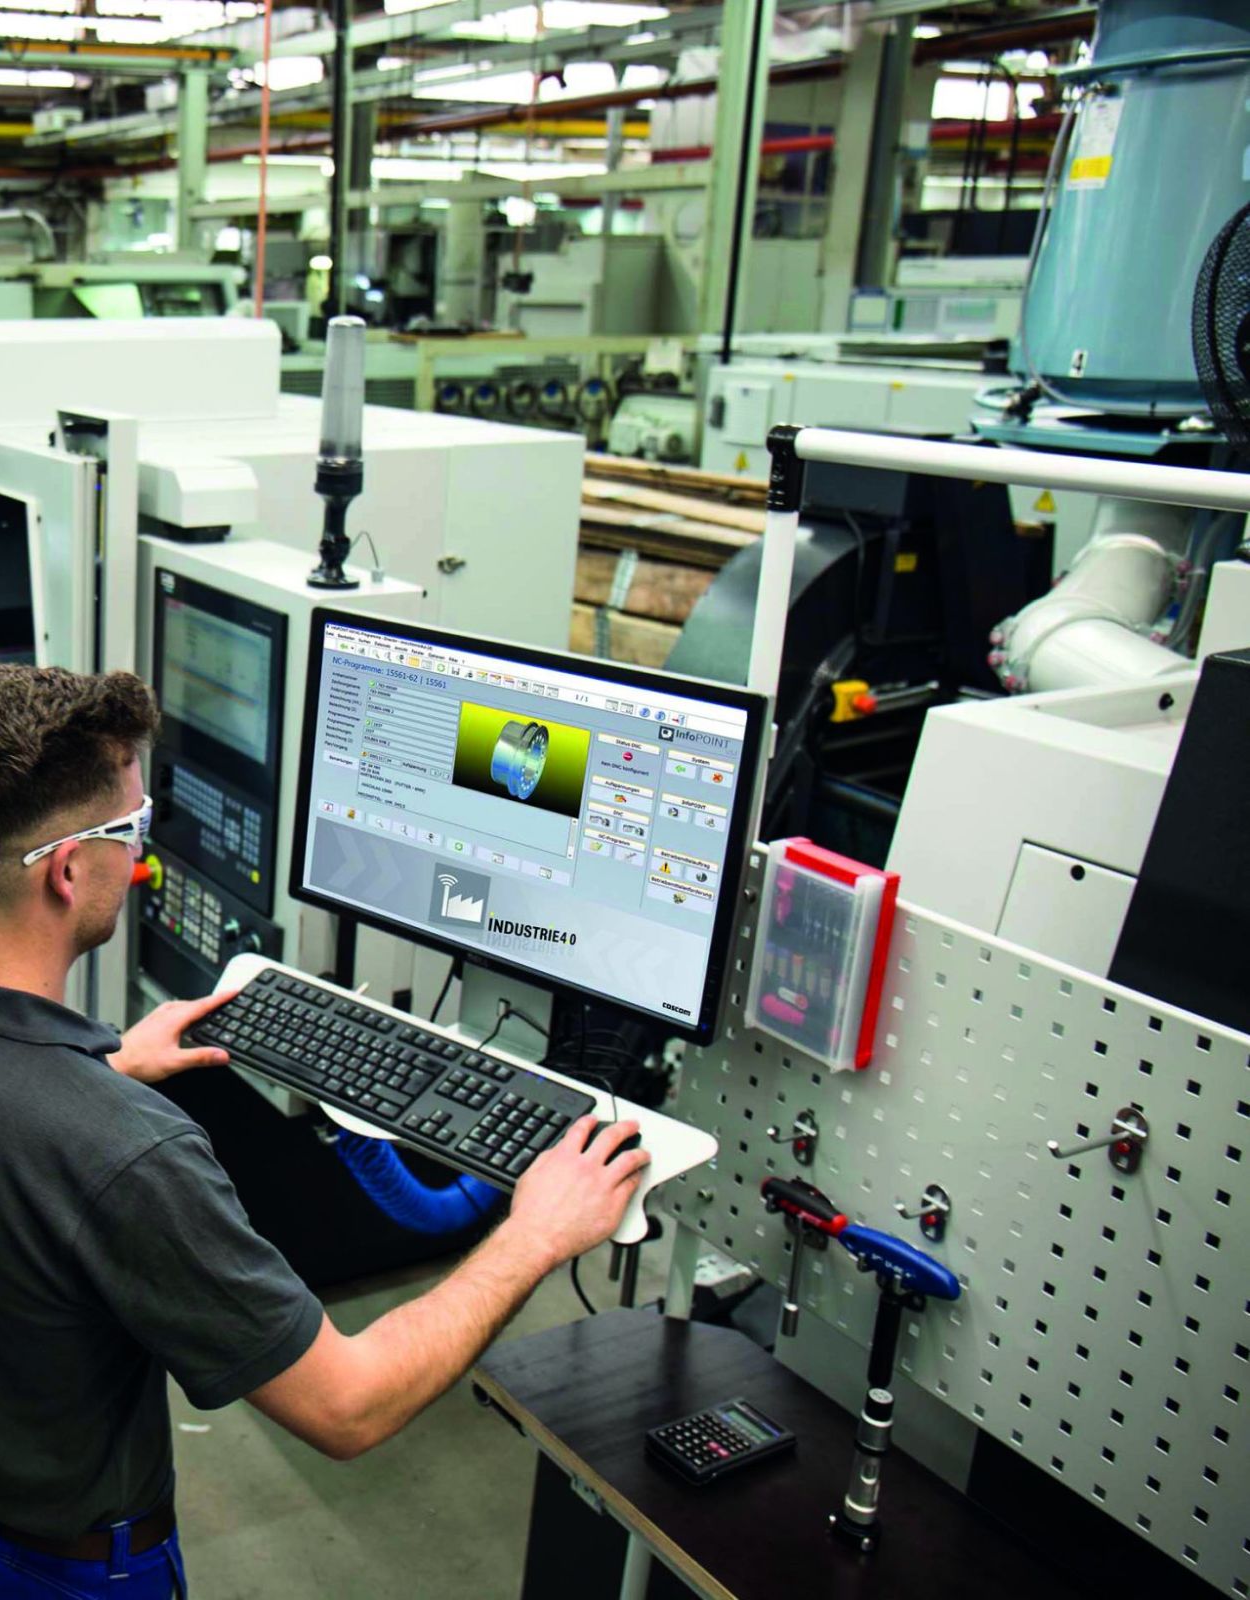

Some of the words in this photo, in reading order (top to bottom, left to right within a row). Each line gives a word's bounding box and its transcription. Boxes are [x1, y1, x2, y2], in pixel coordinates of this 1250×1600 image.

[332, 656, 384, 674] NC-Programme:
[386, 669, 418, 682] 15561-62
[426, 678, 447, 689] 15561
[675, 730, 730, 749] InfoPOINT
[691, 757, 711, 766] System
[662, 1001, 691, 1017] coscom
